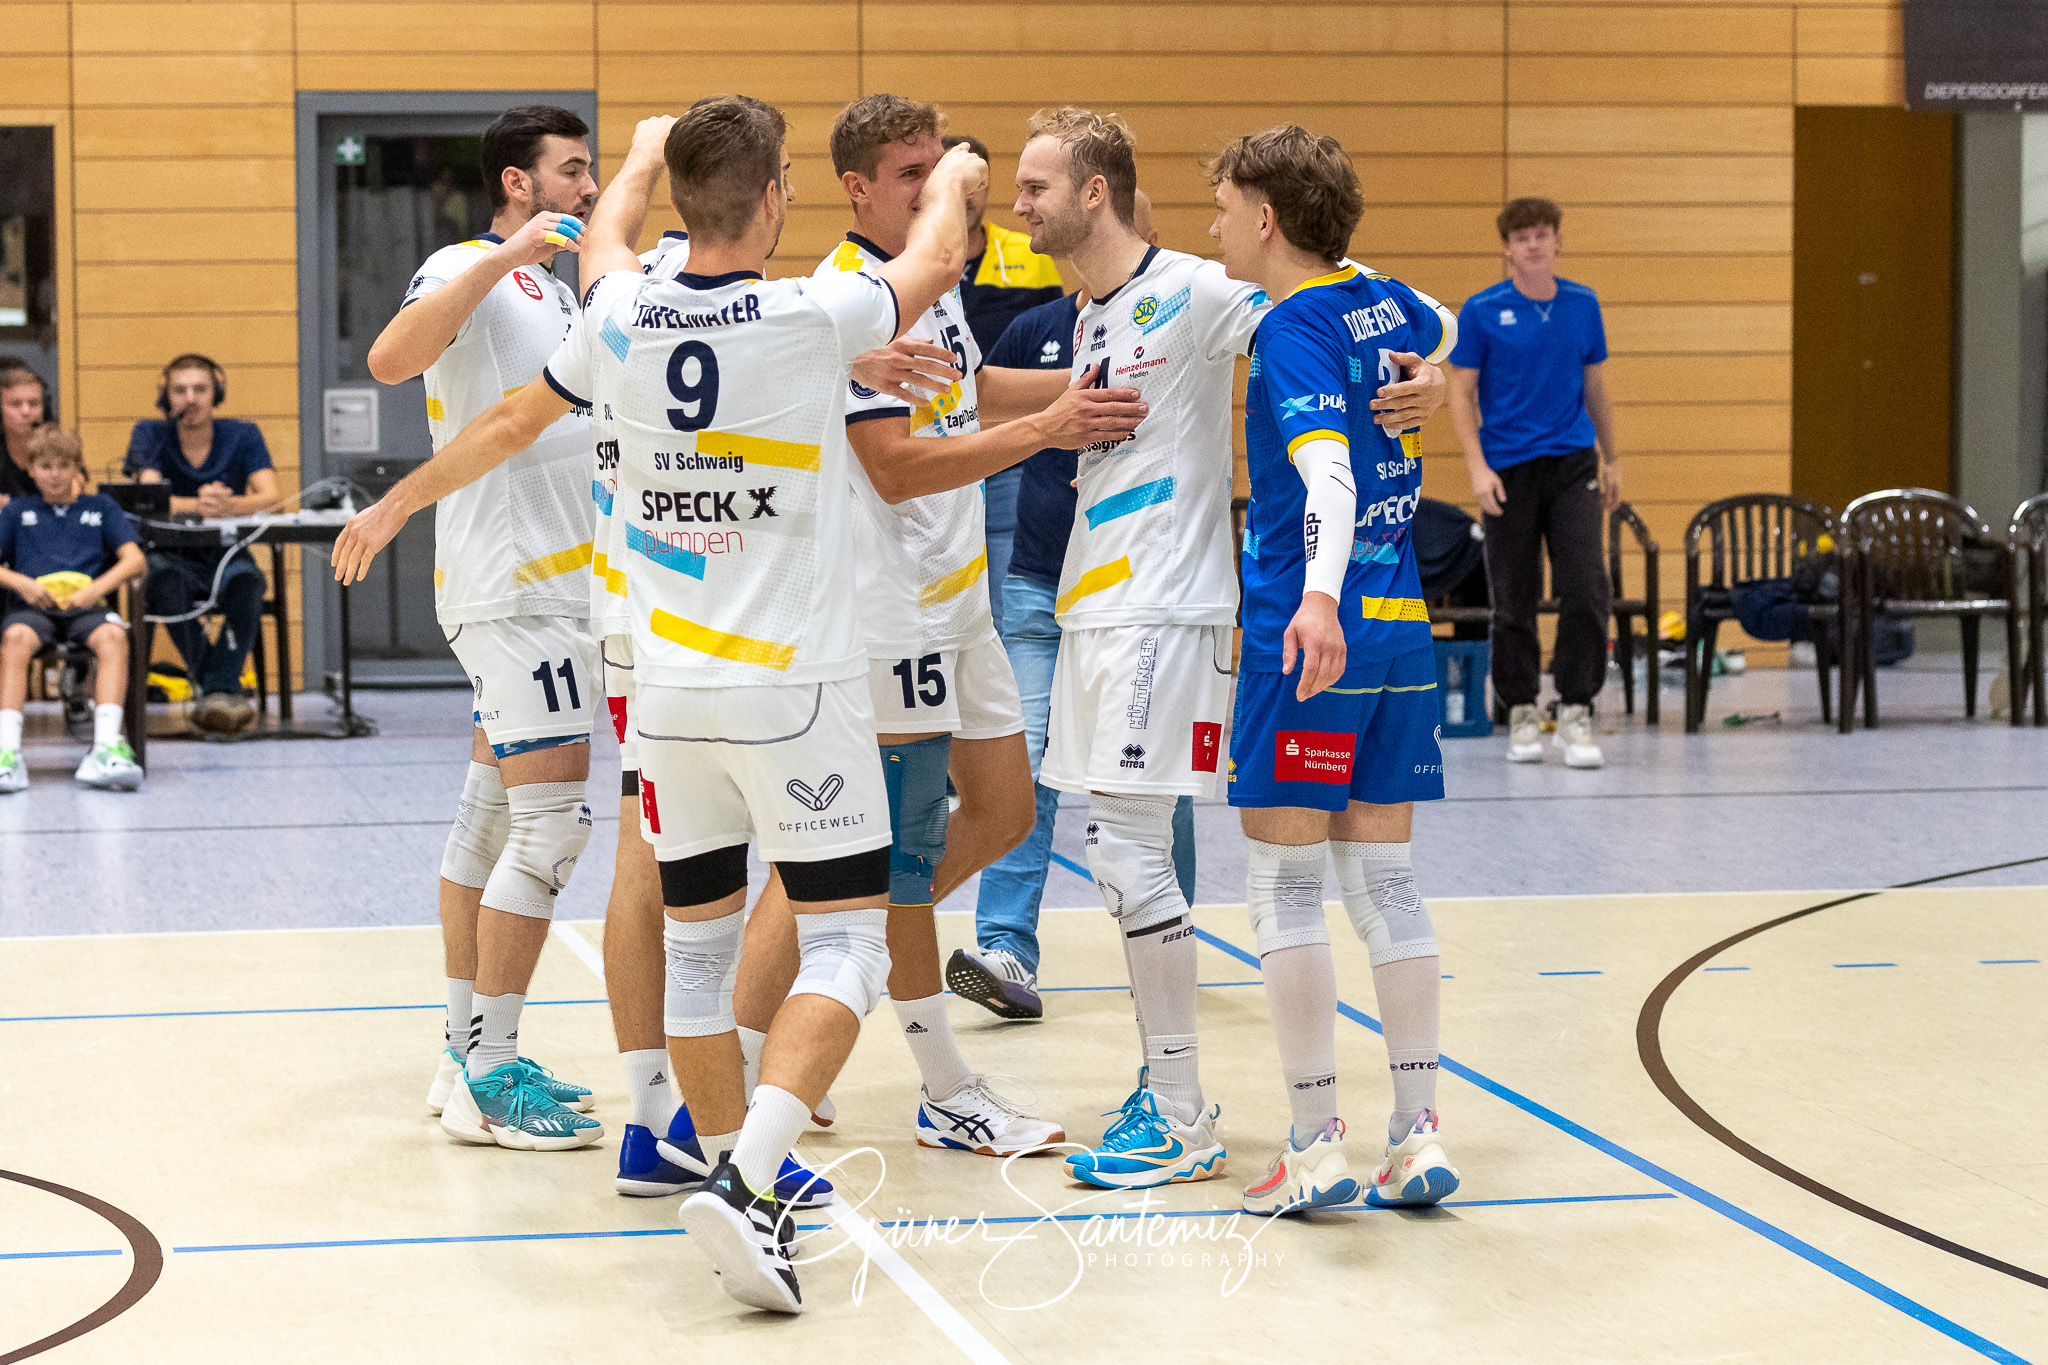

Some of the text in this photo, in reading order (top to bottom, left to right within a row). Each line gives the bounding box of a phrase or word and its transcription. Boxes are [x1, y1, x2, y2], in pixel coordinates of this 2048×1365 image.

[1091, 340, 1106, 352] errea
[1115, 357, 1167, 376] Heinzelmann
[1129, 370, 1149, 379] Medien
[666, 340, 719, 432] 9
[655, 451, 744, 473] SV Schwaig
[642, 489, 740, 523] SPECK
[1306, 512, 1322, 547] cep
[644, 530, 744, 561] pumpen
[532, 658, 581, 713] 11
[892, 652, 947, 709] 15
[1304, 747, 1351, 759] Sparkasse
[1120, 758, 1145, 770] errea
[1304, 760, 1347, 774] Nürnberg
[778, 813, 866, 833] OFFICEWELT
[1315, 1075, 1337, 1088] err
